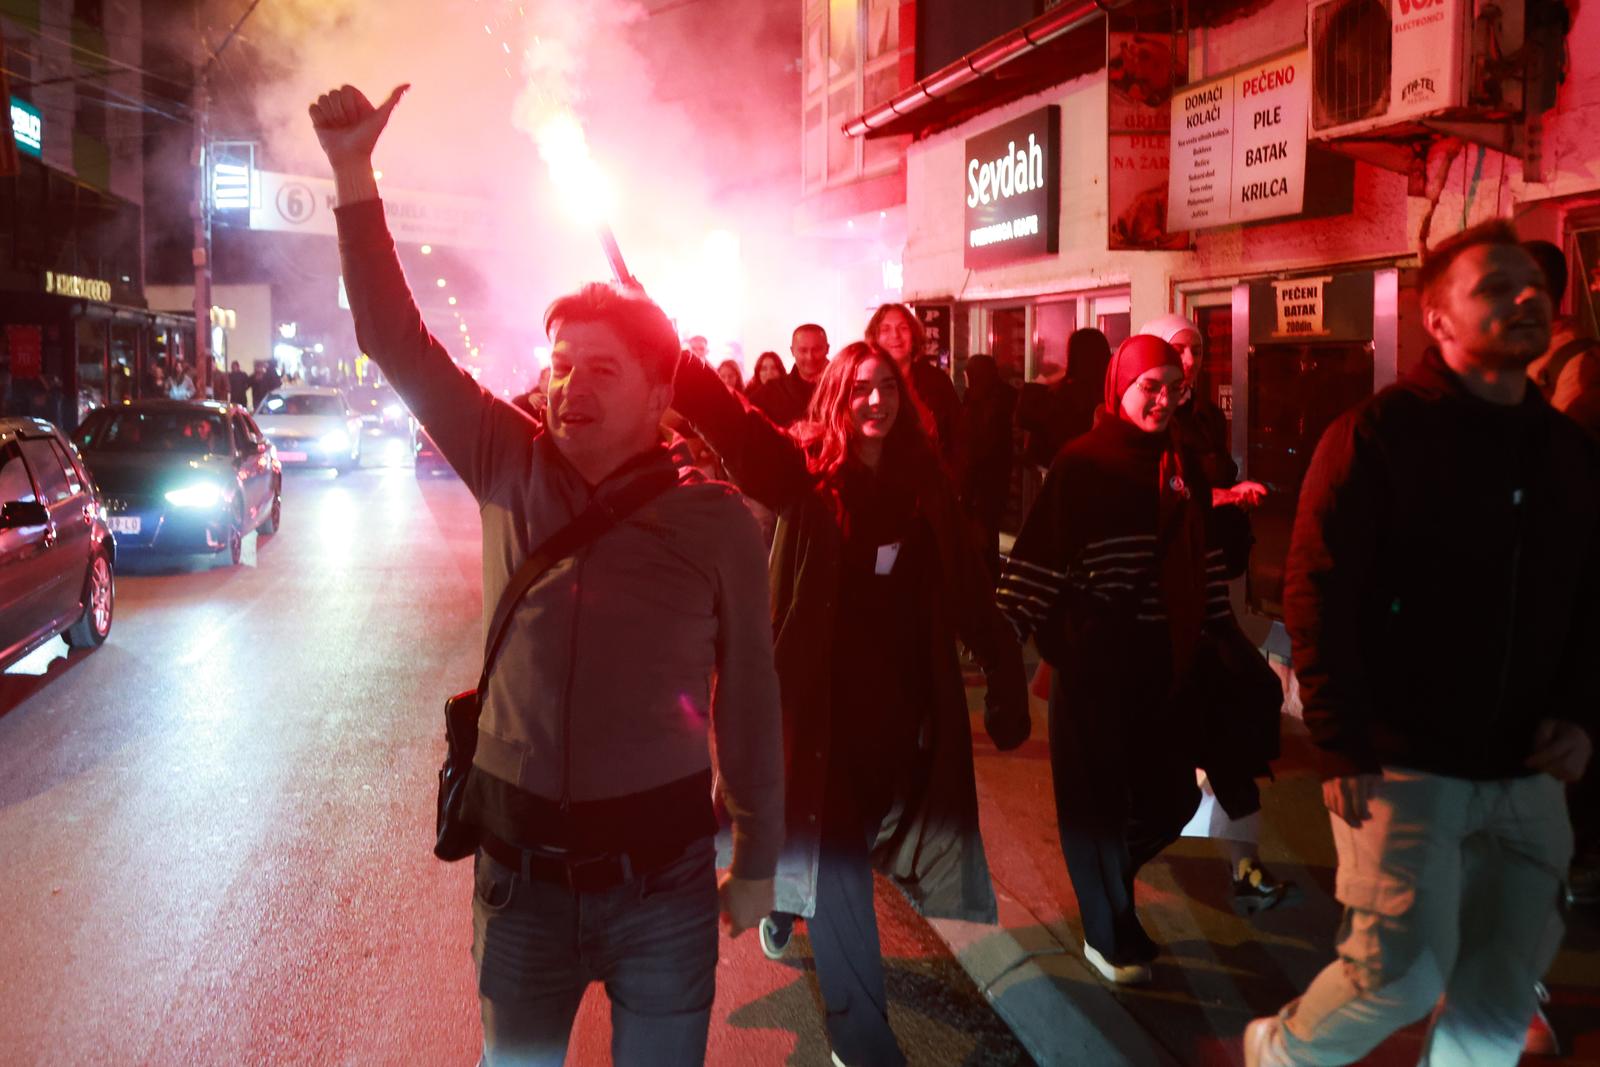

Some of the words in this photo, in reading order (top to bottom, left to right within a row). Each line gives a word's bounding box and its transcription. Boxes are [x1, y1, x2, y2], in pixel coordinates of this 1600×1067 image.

[1242, 65, 1295, 98] PEČENO
[1253, 106, 1282, 130] PILE
[1114, 156, 1135, 169] NA
[1245, 141, 1288, 168] BATAK
[967, 133, 1044, 208] Sevdah
[1241, 177, 1288, 203] KRILCA
[287, 189, 304, 218] 6
[1281, 286, 1318, 301] PEČENI
[1284, 304, 1316, 318] BATAK
